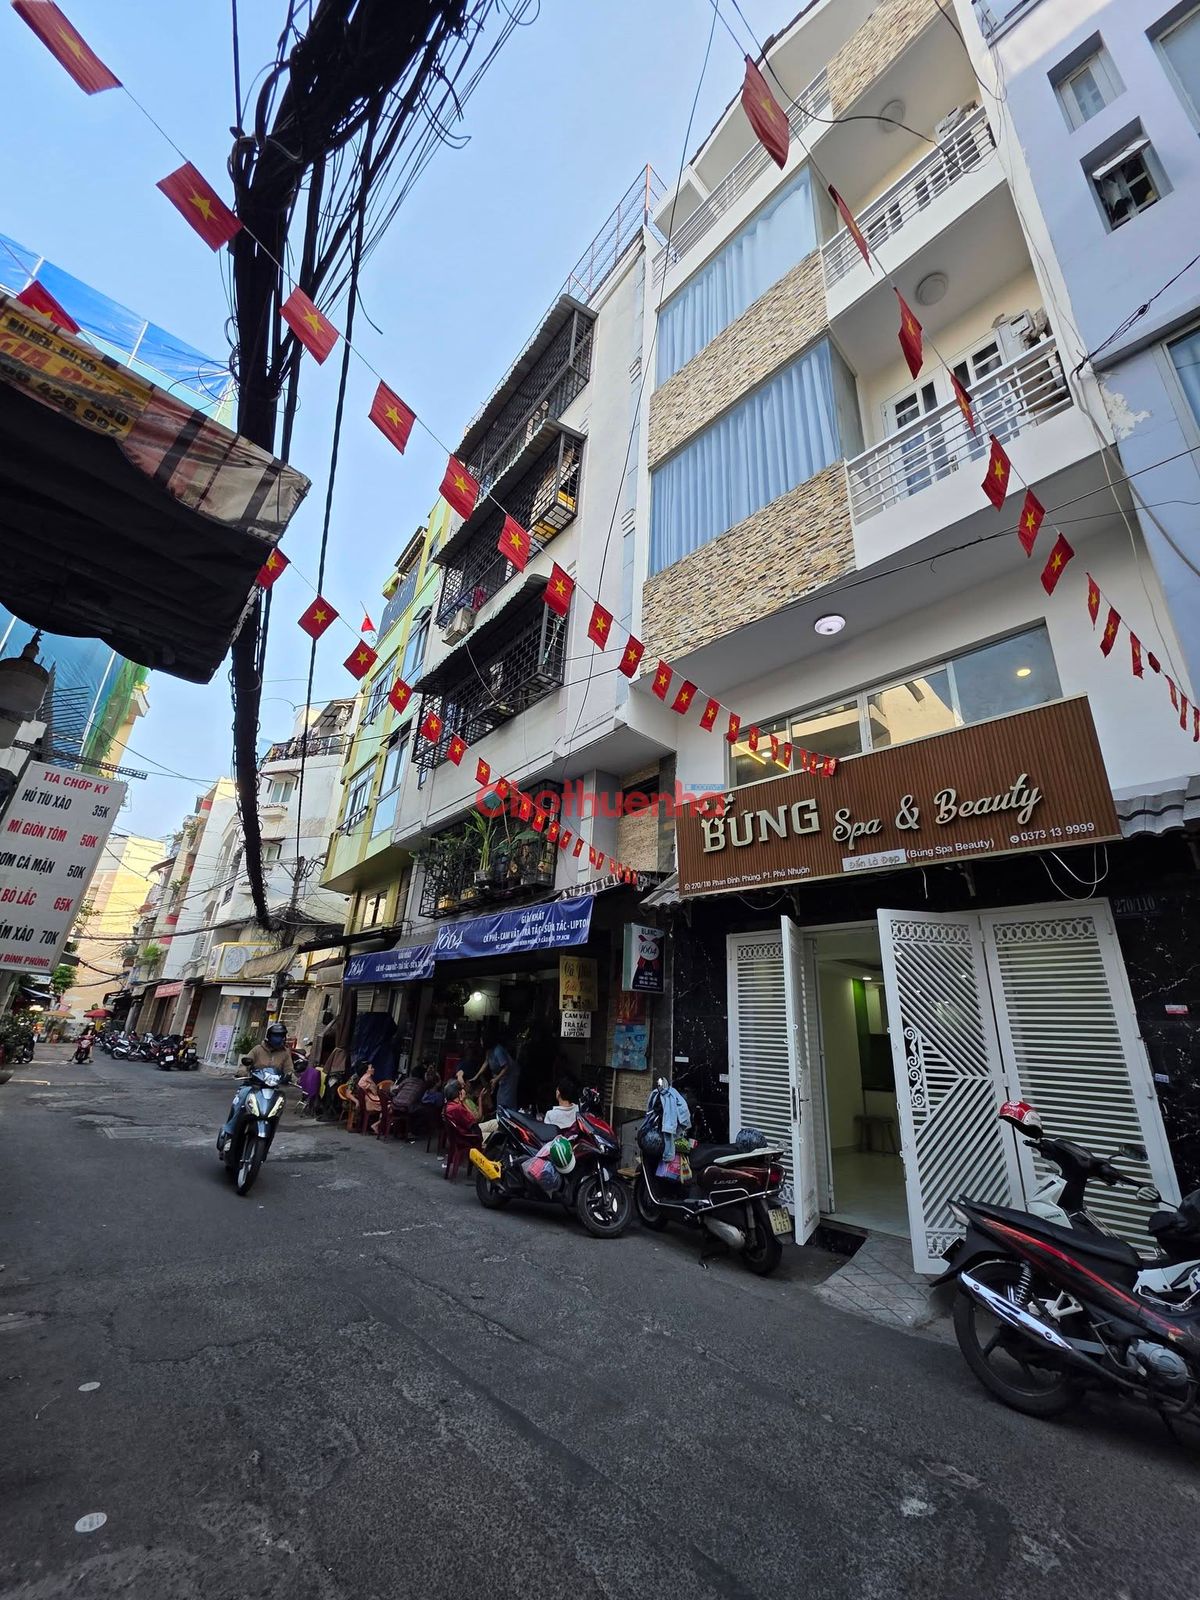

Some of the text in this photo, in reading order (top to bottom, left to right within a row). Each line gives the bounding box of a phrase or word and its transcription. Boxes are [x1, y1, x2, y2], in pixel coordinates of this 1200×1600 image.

[43, 771, 61, 785] TIA
[92, 804, 110, 818] 35K
[832, 807, 883, 850] Spa
[895, 794, 921, 830] &
[934, 773, 1042, 825] Beauty
[1021, 822, 1095, 841] 0373 13 9999
[79, 834, 98, 848] 50K
[935, 845, 953, 856] Spa
[955, 838, 995, 851] Beauty)
[67, 864, 86, 879] 50K
[712, 879, 727, 887] Phan
[53, 897, 73, 912] 65K
[39, 930, 60, 945] 70K
